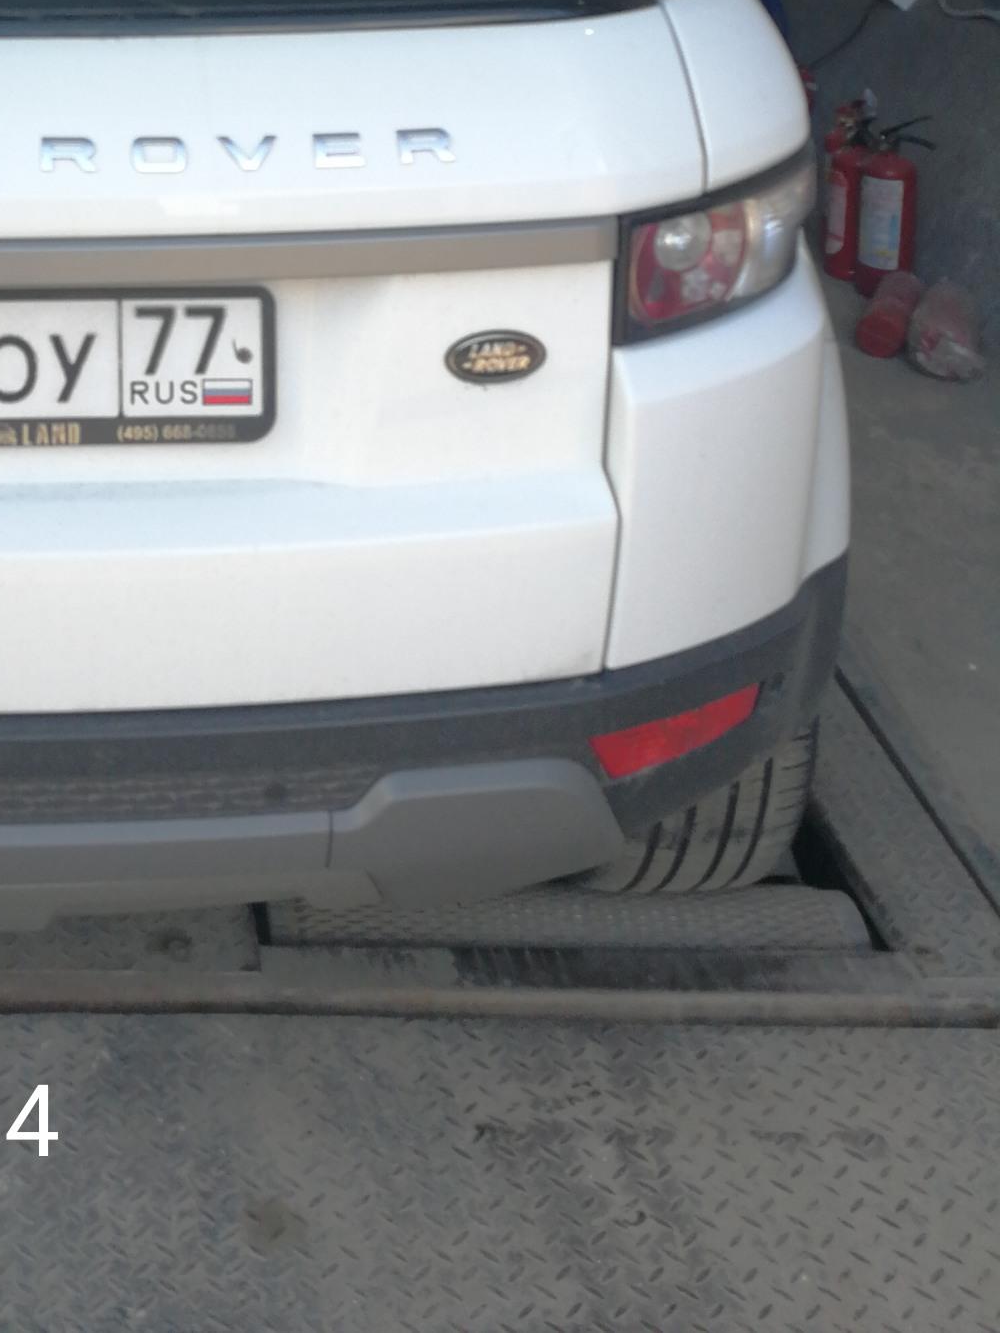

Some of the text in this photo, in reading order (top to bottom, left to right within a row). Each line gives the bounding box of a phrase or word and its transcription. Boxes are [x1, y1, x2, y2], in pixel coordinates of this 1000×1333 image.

[39, 128, 456, 174] ROVER
[134, 305, 228, 375] 77
[130, 380, 198, 406] RUS
[22, 422, 81, 445] LAND
